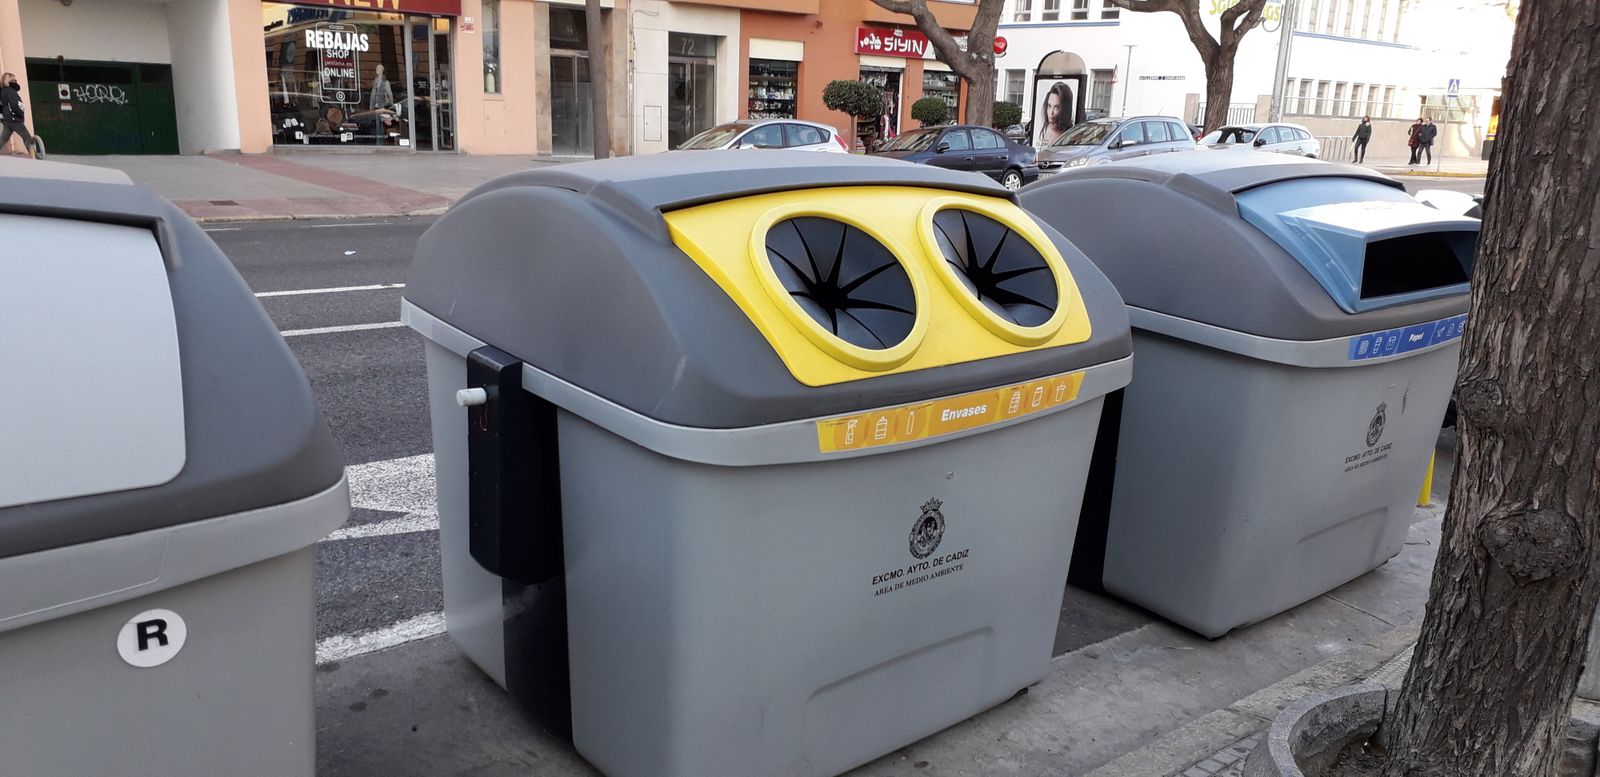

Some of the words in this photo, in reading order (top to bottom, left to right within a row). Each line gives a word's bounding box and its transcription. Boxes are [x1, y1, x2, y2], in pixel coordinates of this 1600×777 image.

[305, 29, 369, 52] REBAJAS
[680, 37, 696, 56] 72
[884, 37, 923, 55] SIYIN
[326, 49, 350, 59] SHOP
[324, 67, 355, 78] ONLINE
[941, 403, 987, 423] Envases
[872, 569, 905, 585] EXCMO.
[906, 561, 931, 575] AYTO.
[933, 556, 945, 567] DE
[945, 549, 970, 563] CADIZ
[874, 586, 893, 597] AREA
[894, 582, 904, 591] DE
[904, 575, 929, 586] MEDIO
[929, 564, 964, 580] AMBIENTE
[136, 618, 169, 652] R
